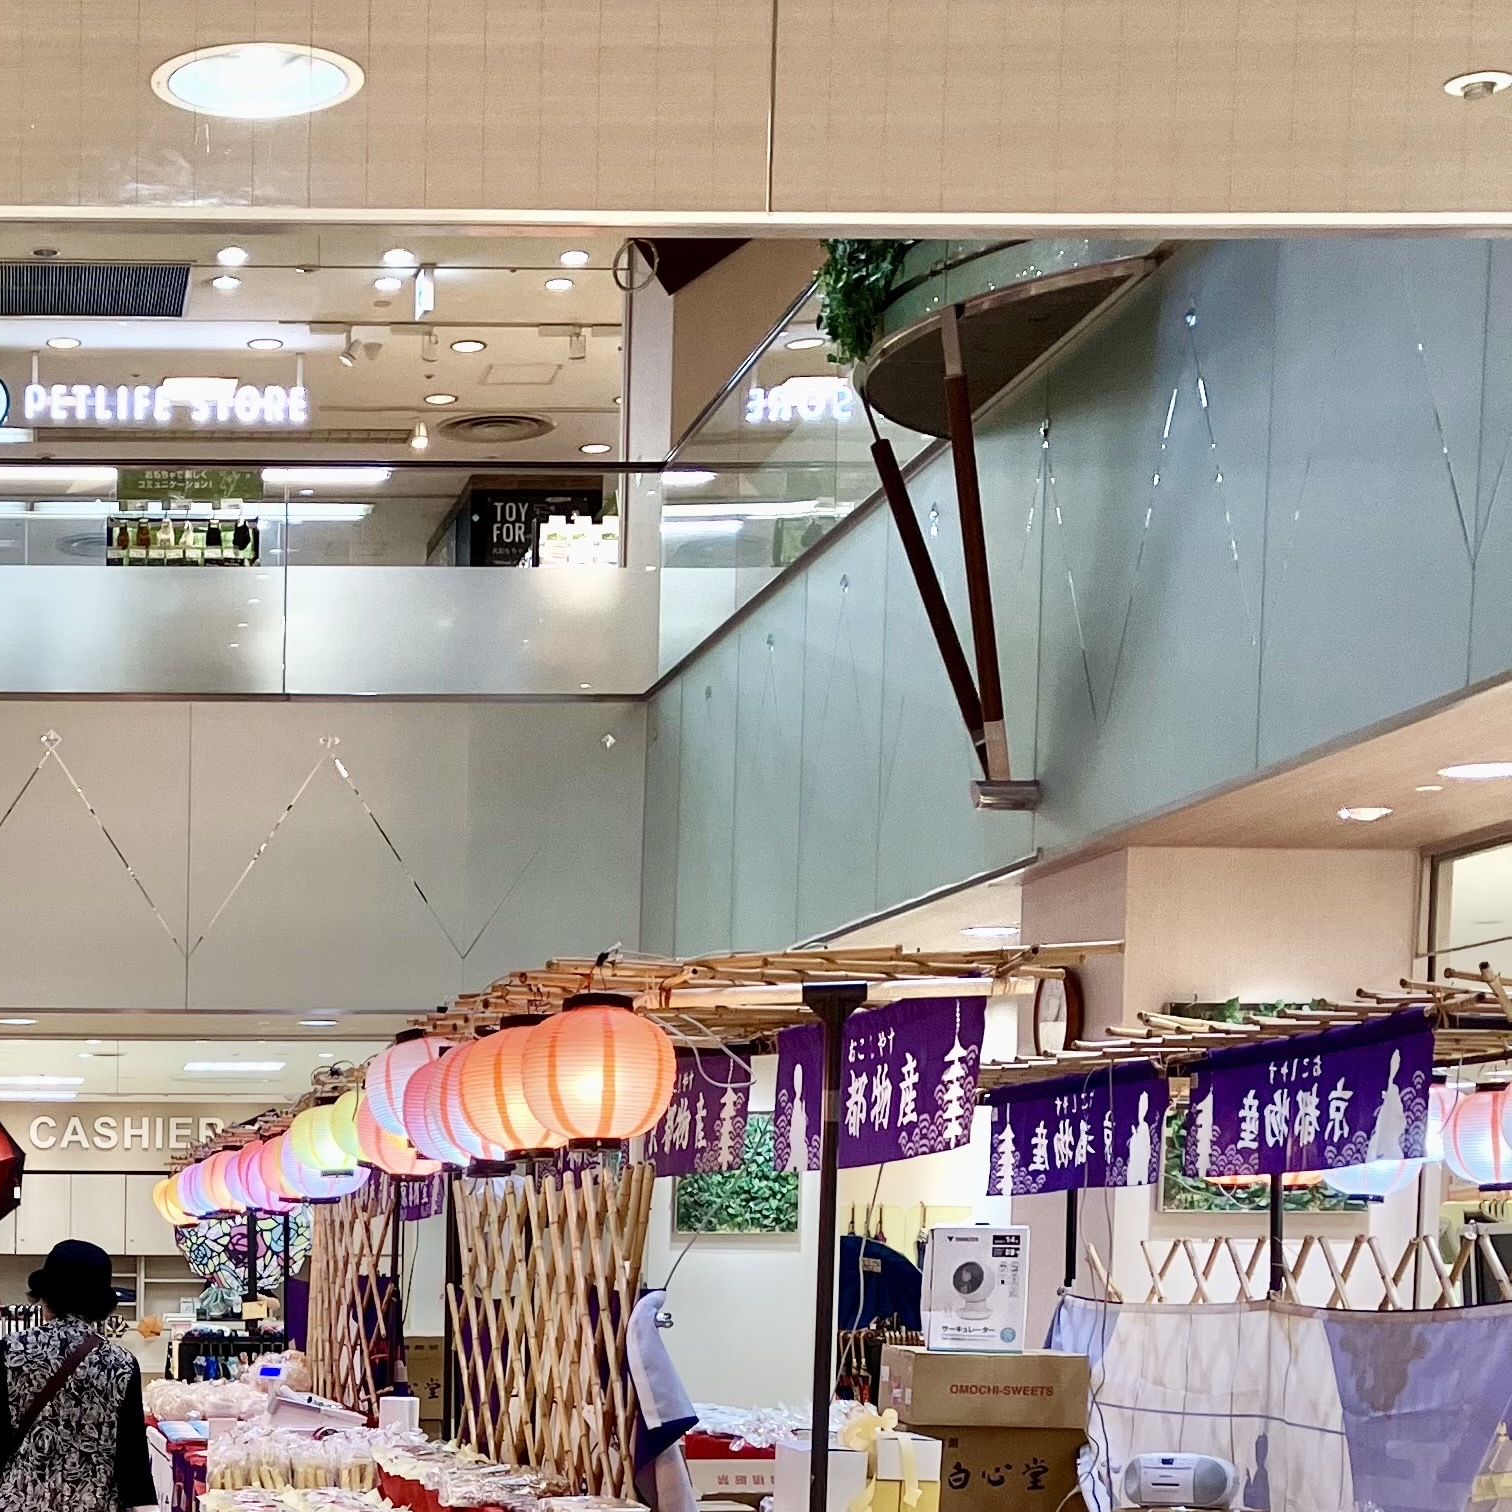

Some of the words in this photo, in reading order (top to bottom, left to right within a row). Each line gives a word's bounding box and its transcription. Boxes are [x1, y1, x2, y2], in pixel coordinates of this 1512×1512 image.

[24, 384, 172, 421] PETLIFE
[493, 502, 529, 522] TOY
[492, 523, 525, 543] FOR
[844, 1052, 919, 1139] 都物産
[29, 1115, 225, 1150] CASHIER
[949, 1384, 1054, 1397] OMOCHI-SWEETS
[948, 1457, 1049, 1490] 白心堂
